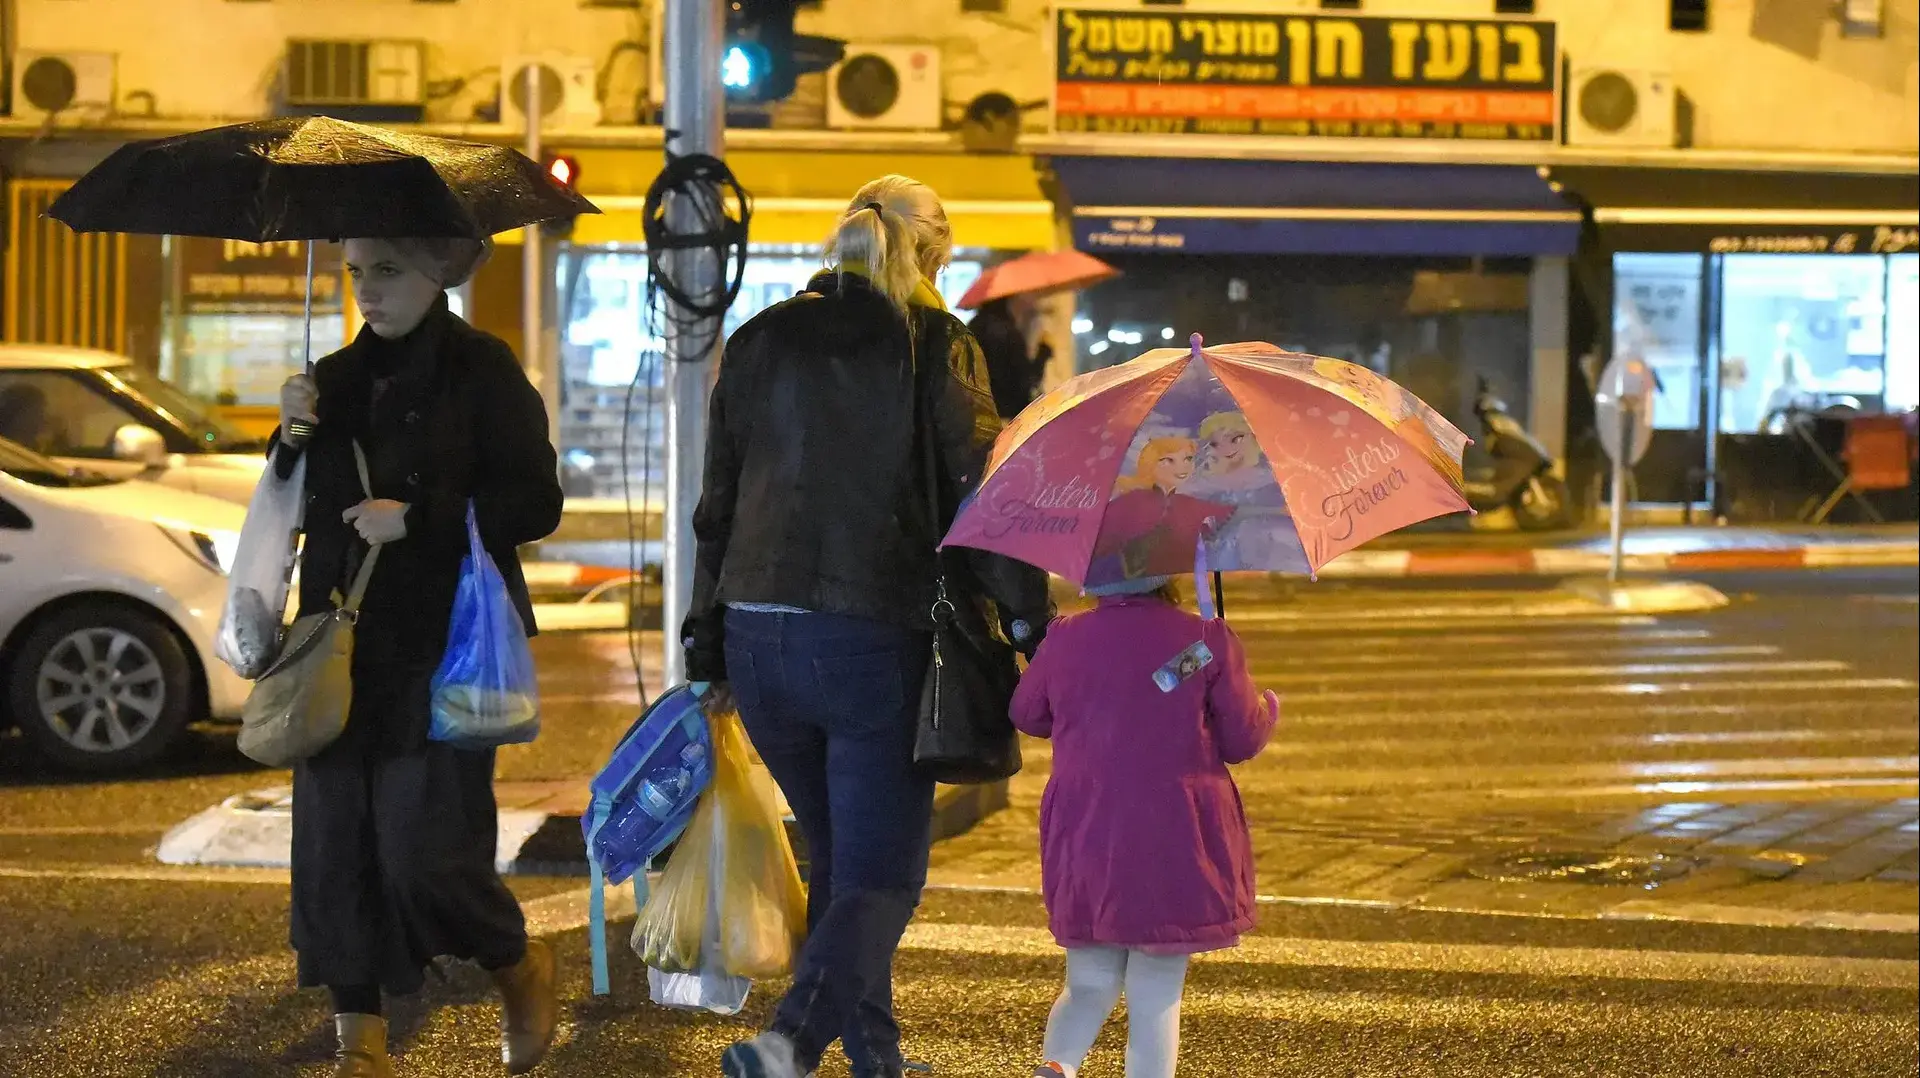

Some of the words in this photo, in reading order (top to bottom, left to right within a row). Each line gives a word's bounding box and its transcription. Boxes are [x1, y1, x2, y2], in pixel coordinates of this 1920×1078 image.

[1064, 10, 1173, 52] חשמל
[1179, 19, 1279, 55] מוצרי
[1286, 18, 1363, 86] חן
[1389, 21, 1544, 82] בועז
[983, 500, 1080, 539] Forever
[1322, 466, 1409, 541] Forever
